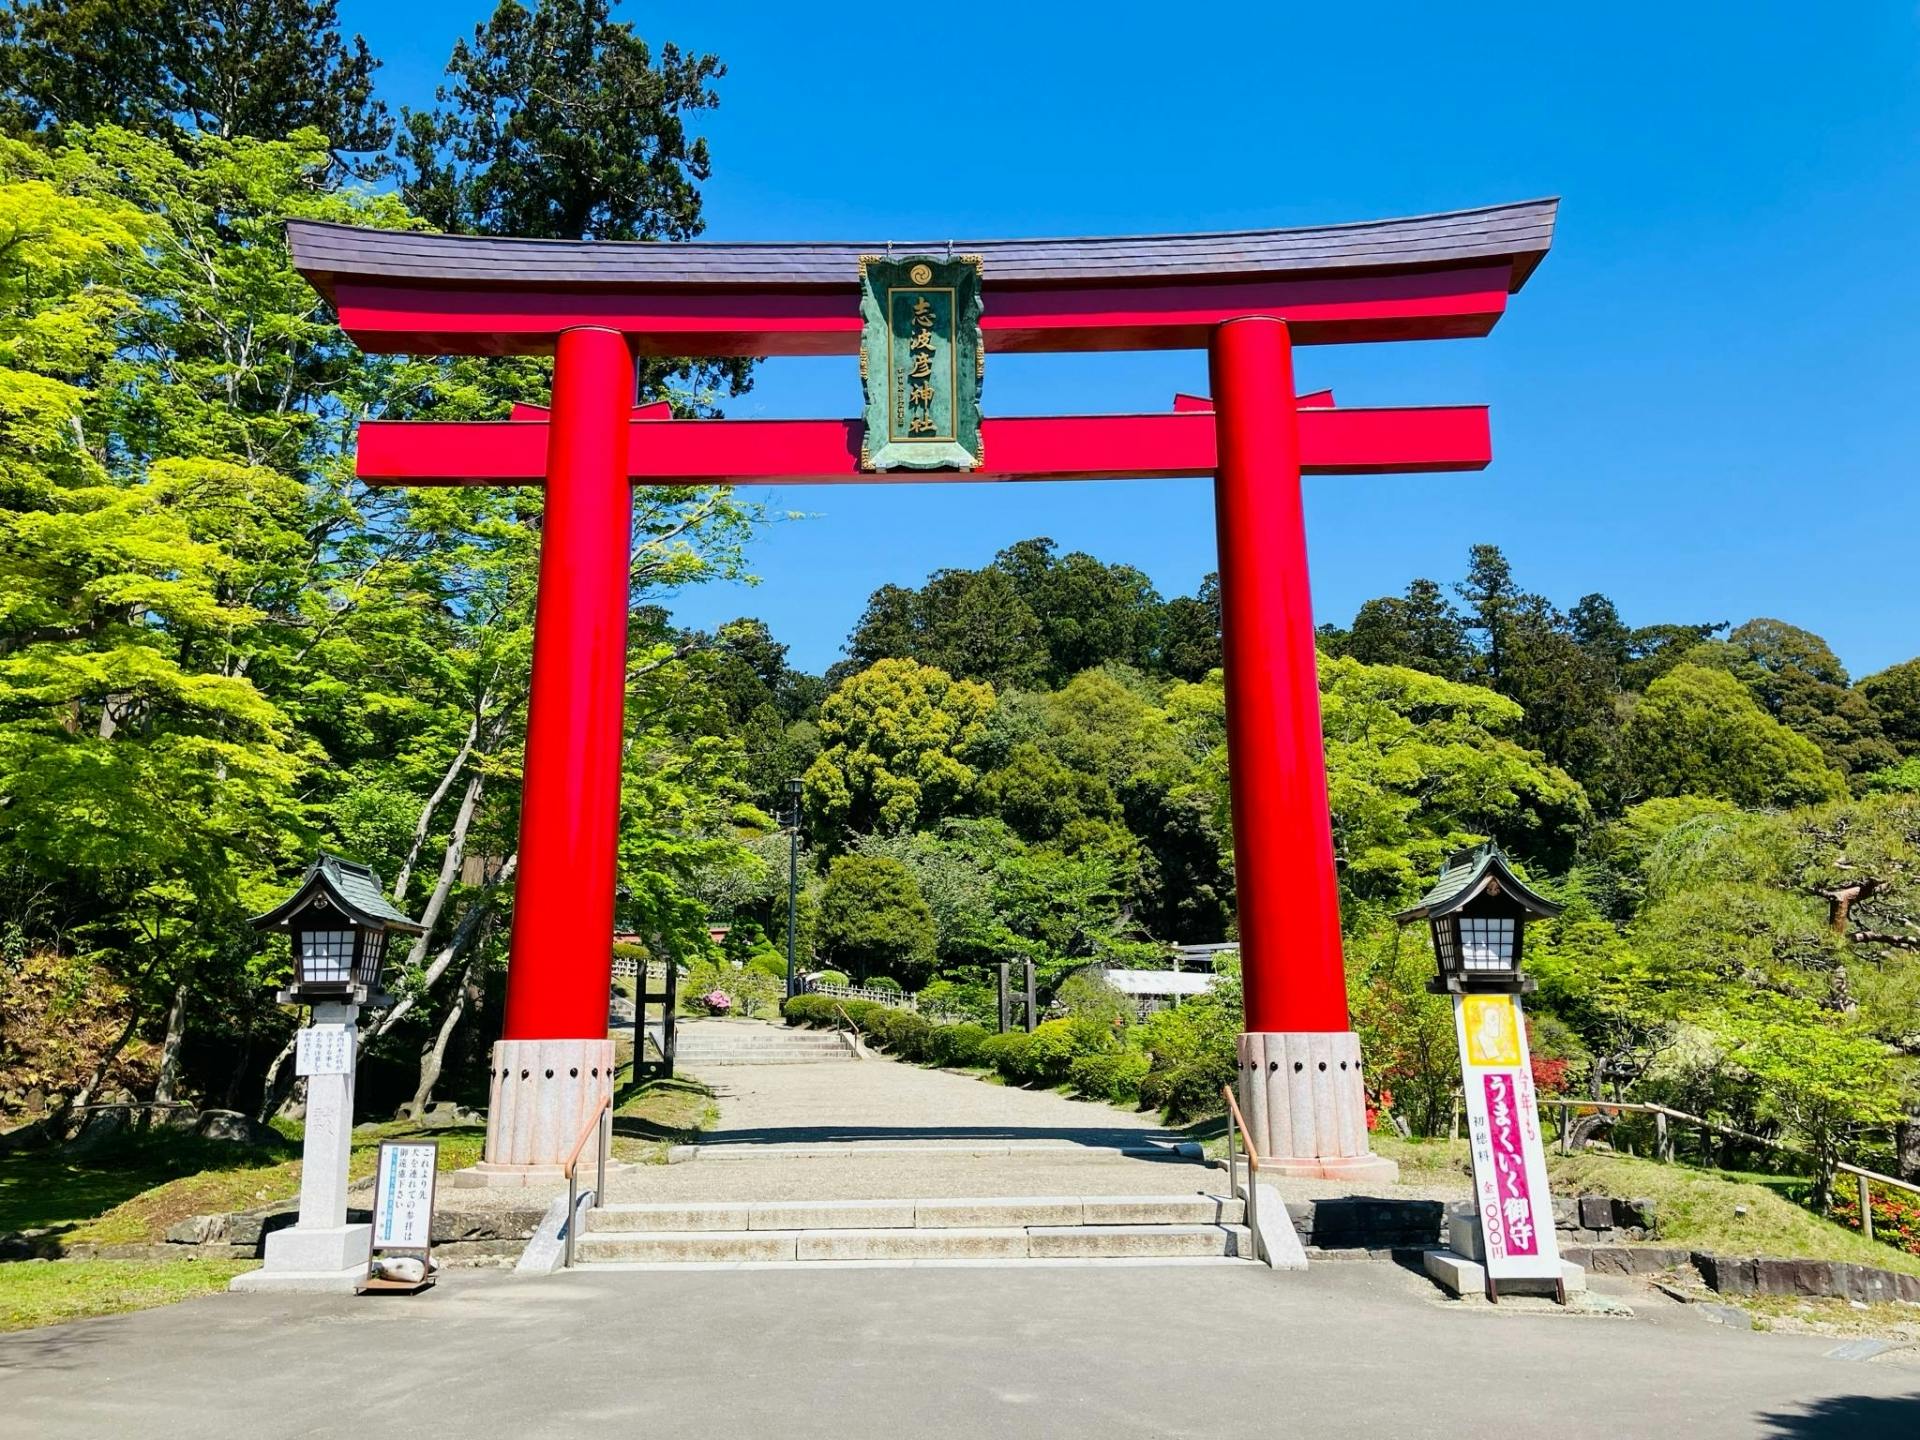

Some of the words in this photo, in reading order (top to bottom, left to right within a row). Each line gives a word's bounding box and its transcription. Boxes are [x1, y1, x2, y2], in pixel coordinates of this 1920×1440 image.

[908, 296, 938, 433] 志波彦神社
[1474, 1115, 1489, 1162] 初穂料
[1518, 1068, 1536, 1141] 今年も
[395, 1148, 408, 1209] 御遠慮下さい
[404, 1148, 420, 1241] 犬を連れての参拝は
[418, 1149, 430, 1200] これより先
[1489, 1075, 1533, 1251] うまくいく御守
